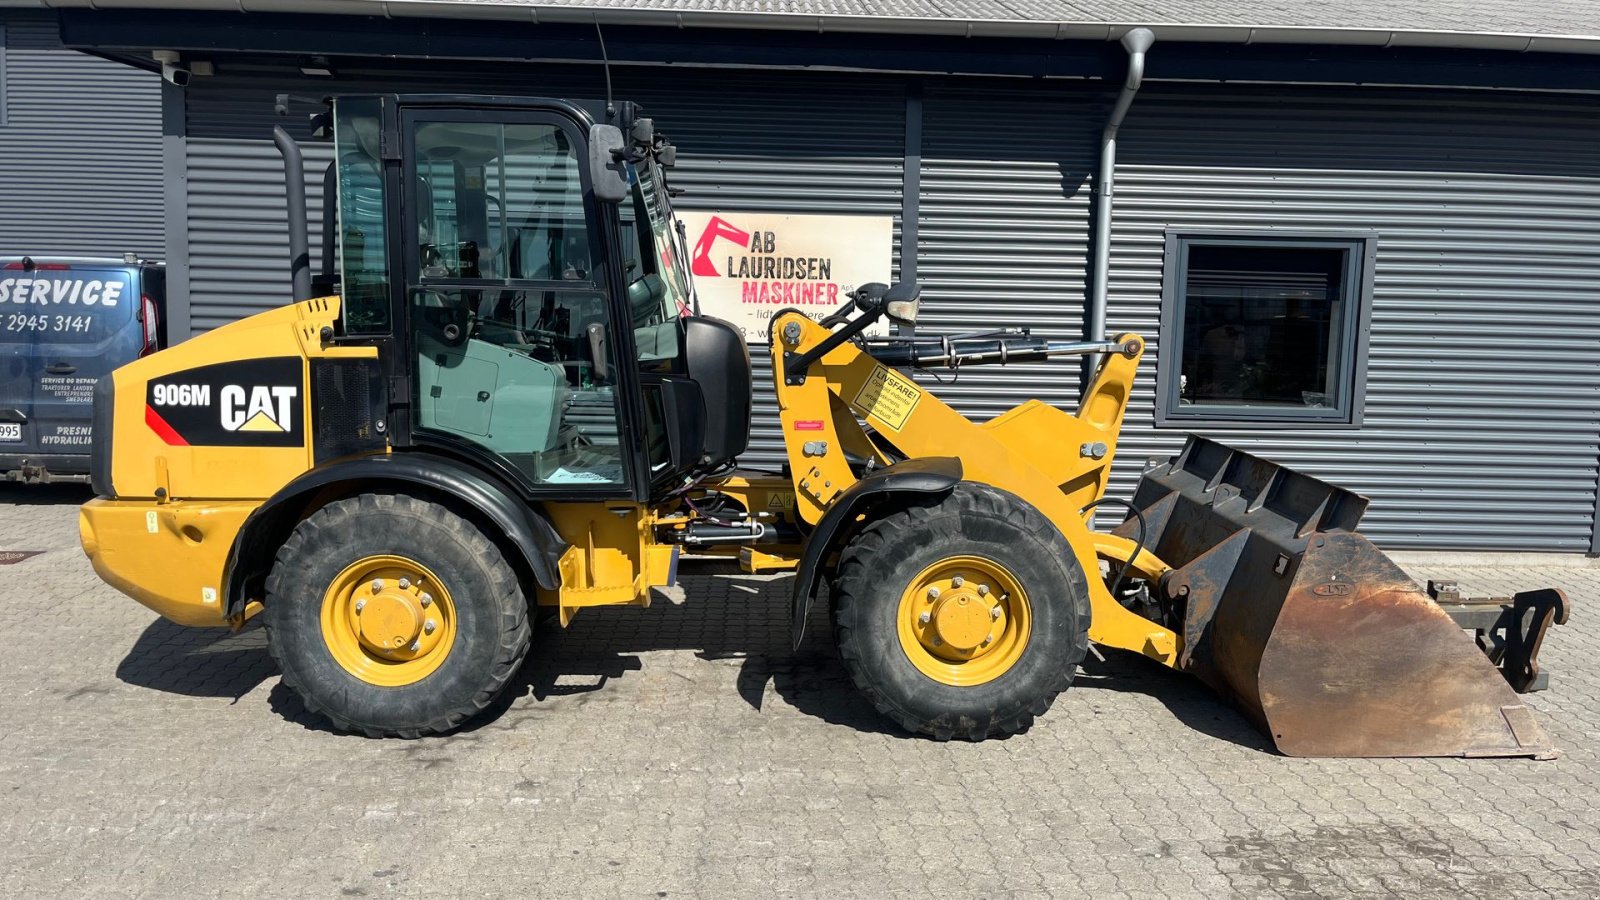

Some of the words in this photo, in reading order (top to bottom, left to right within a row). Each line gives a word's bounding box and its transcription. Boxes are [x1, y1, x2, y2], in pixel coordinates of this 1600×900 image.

[751, 231, 776, 254] AB
[727, 256, 831, 280] LAURIDSEN
[0, 278, 124, 306] SERVICE
[742, 281, 838, 305] MASKINER
[7, 315, 48, 332] 2945
[54, 315, 91, 332] 3141
[876, 371, 917, 401] LIVSFARE!
[153, 384, 211, 406] 906M
[220, 384, 297, 433] CAT
